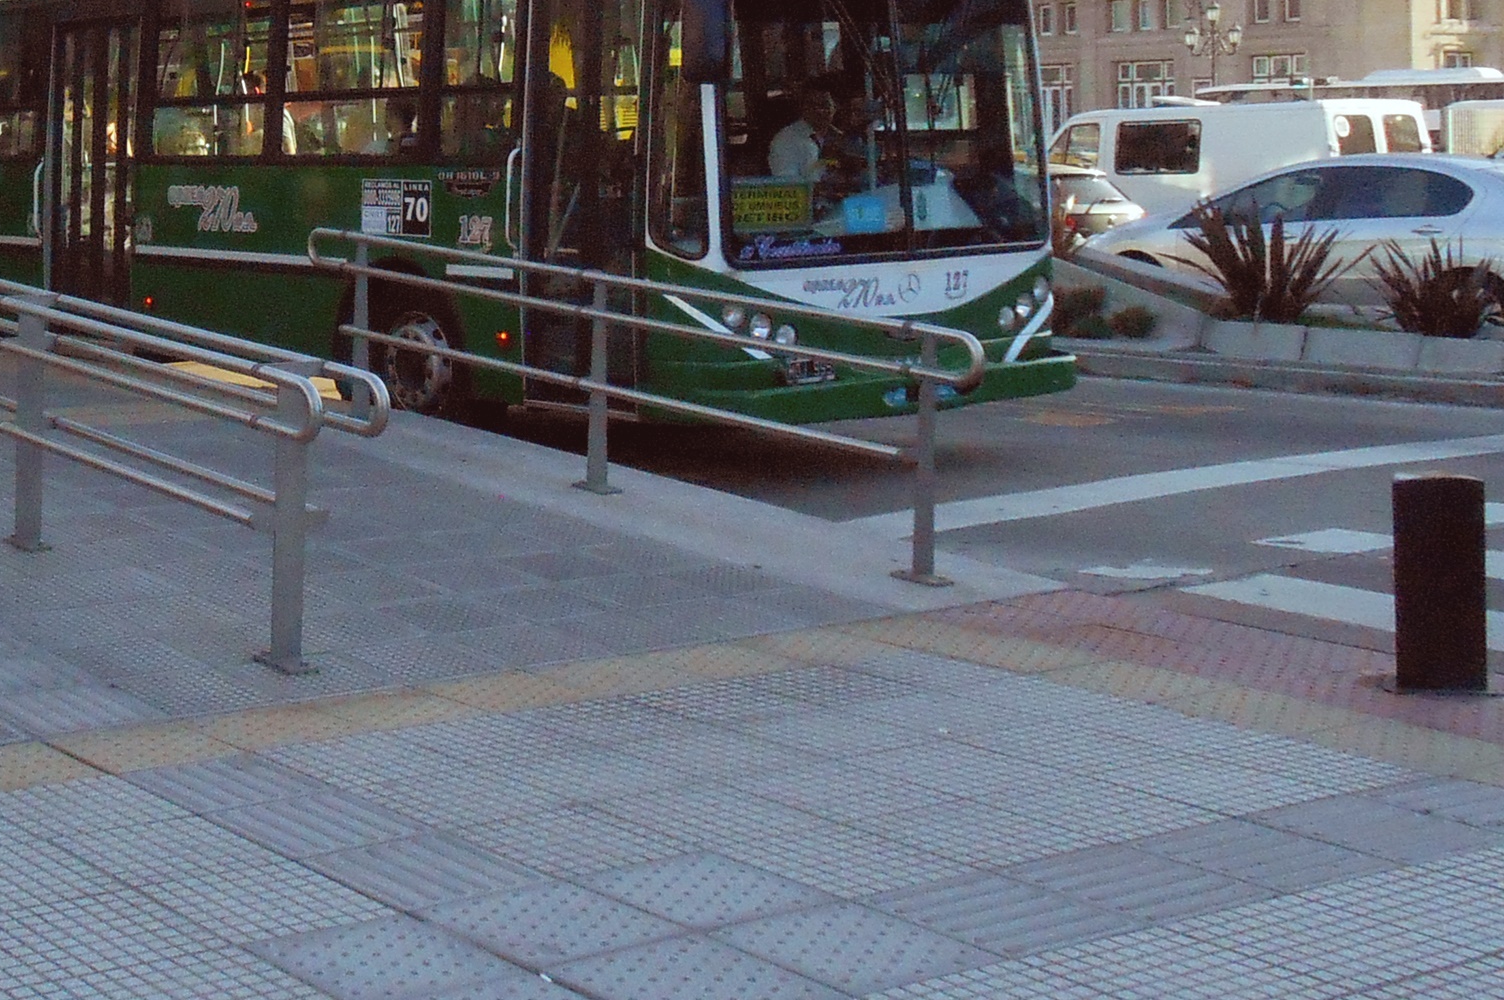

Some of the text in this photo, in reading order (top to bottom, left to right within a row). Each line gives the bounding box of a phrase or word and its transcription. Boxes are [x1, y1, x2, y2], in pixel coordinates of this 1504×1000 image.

[404, 183, 430, 192] LINEA
[404, 196, 429, 223] 70
[387, 214, 401, 234] 127
[459, 214, 493, 246] 127
[945, 270, 969, 292] 127
